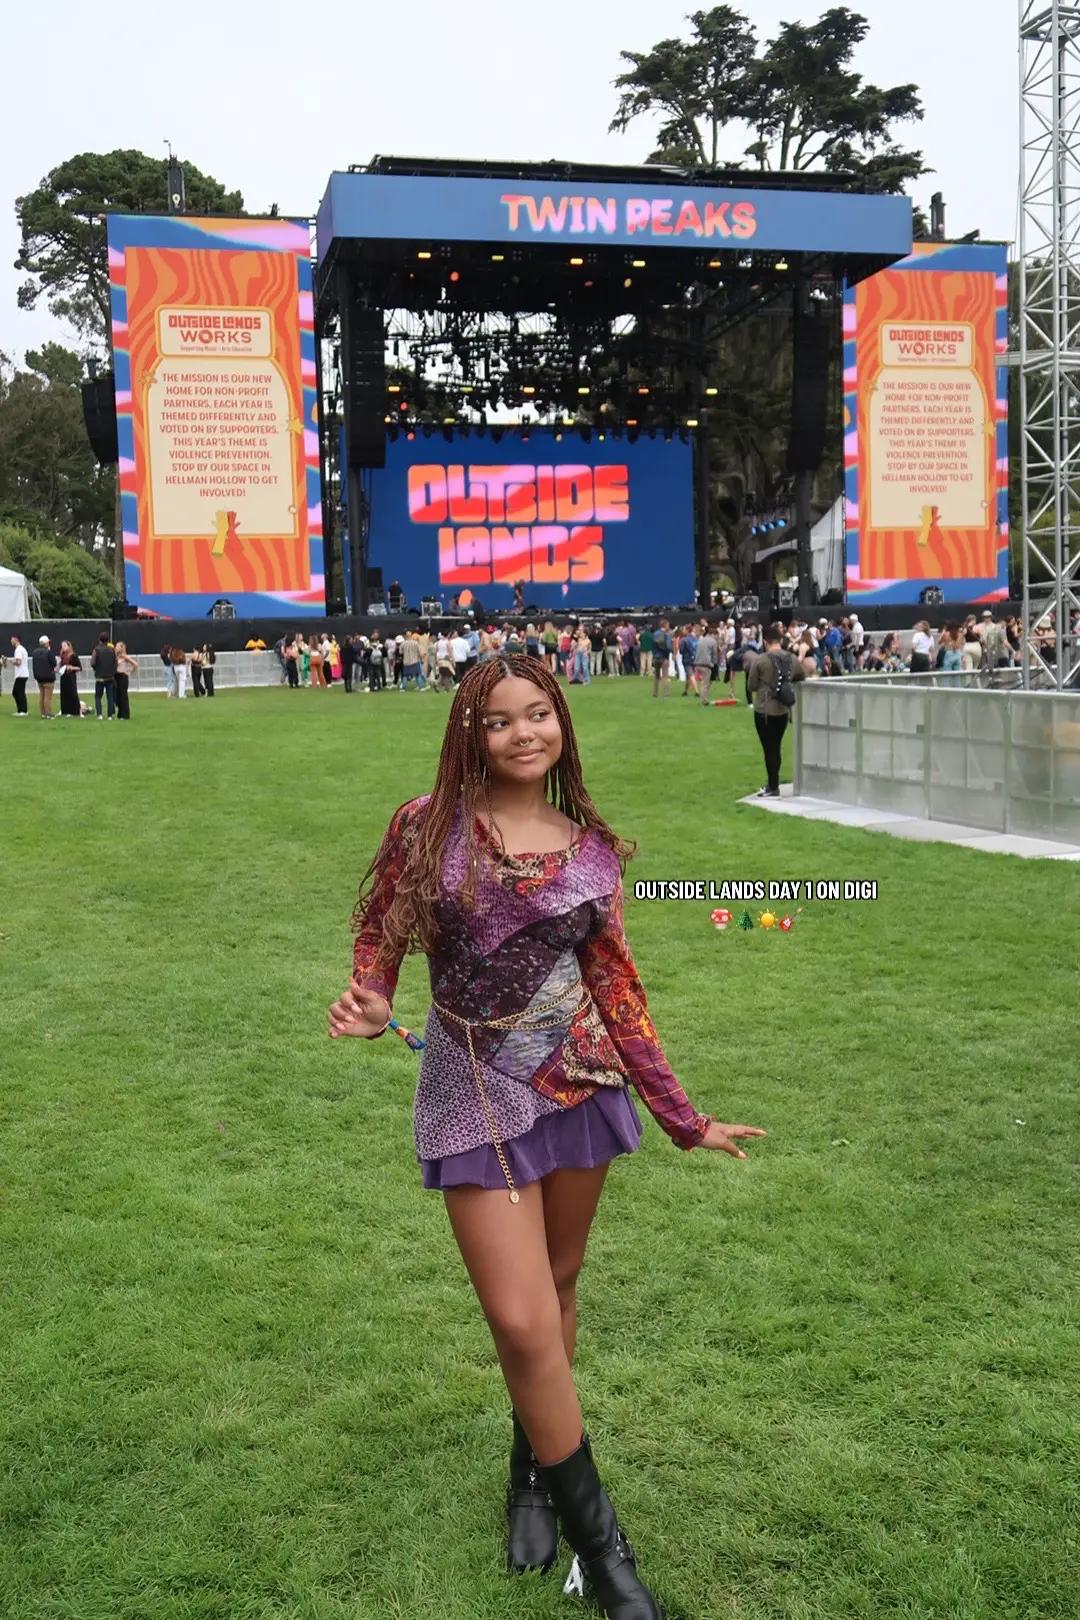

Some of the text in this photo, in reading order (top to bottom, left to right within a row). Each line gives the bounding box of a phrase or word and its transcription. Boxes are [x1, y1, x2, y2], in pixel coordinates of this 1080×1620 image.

[501, 194, 757, 239] TWIN PEAKS
[180, 329, 252, 344] WORKS
[898, 342, 957, 355] WORKS
[162, 373, 272, 383] THE MISSION IS OUR NEW
[166, 386, 269, 396] HOME FOR NON-PROFIT
[214, 399, 237, 409] EACH
[240, 399, 262, 409] YEAR
[264, 399, 273, 409] IS
[161, 412, 277, 421] THEMED DIFFERENTLY AND
[160, 425, 188, 434] VOTED
[191, 425, 204, 434] ON
[206, 425, 218, 434] BY
[173, 437, 192, 447] THIS
[228, 437, 257, 447] THEME
[259, 437, 268, 447] IS
[169, 450, 212, 459] VIOLENCE
[172, 463, 271, 472] STOP BY OUR SPACE IN
[165, 476, 278, 485] HELLMAN HOLLOW TO GET
[199, 488, 246, 497] INVOLVED!
[408, 464, 630, 523] OUTSIDE
[438, 526, 605, 585] LANDS
